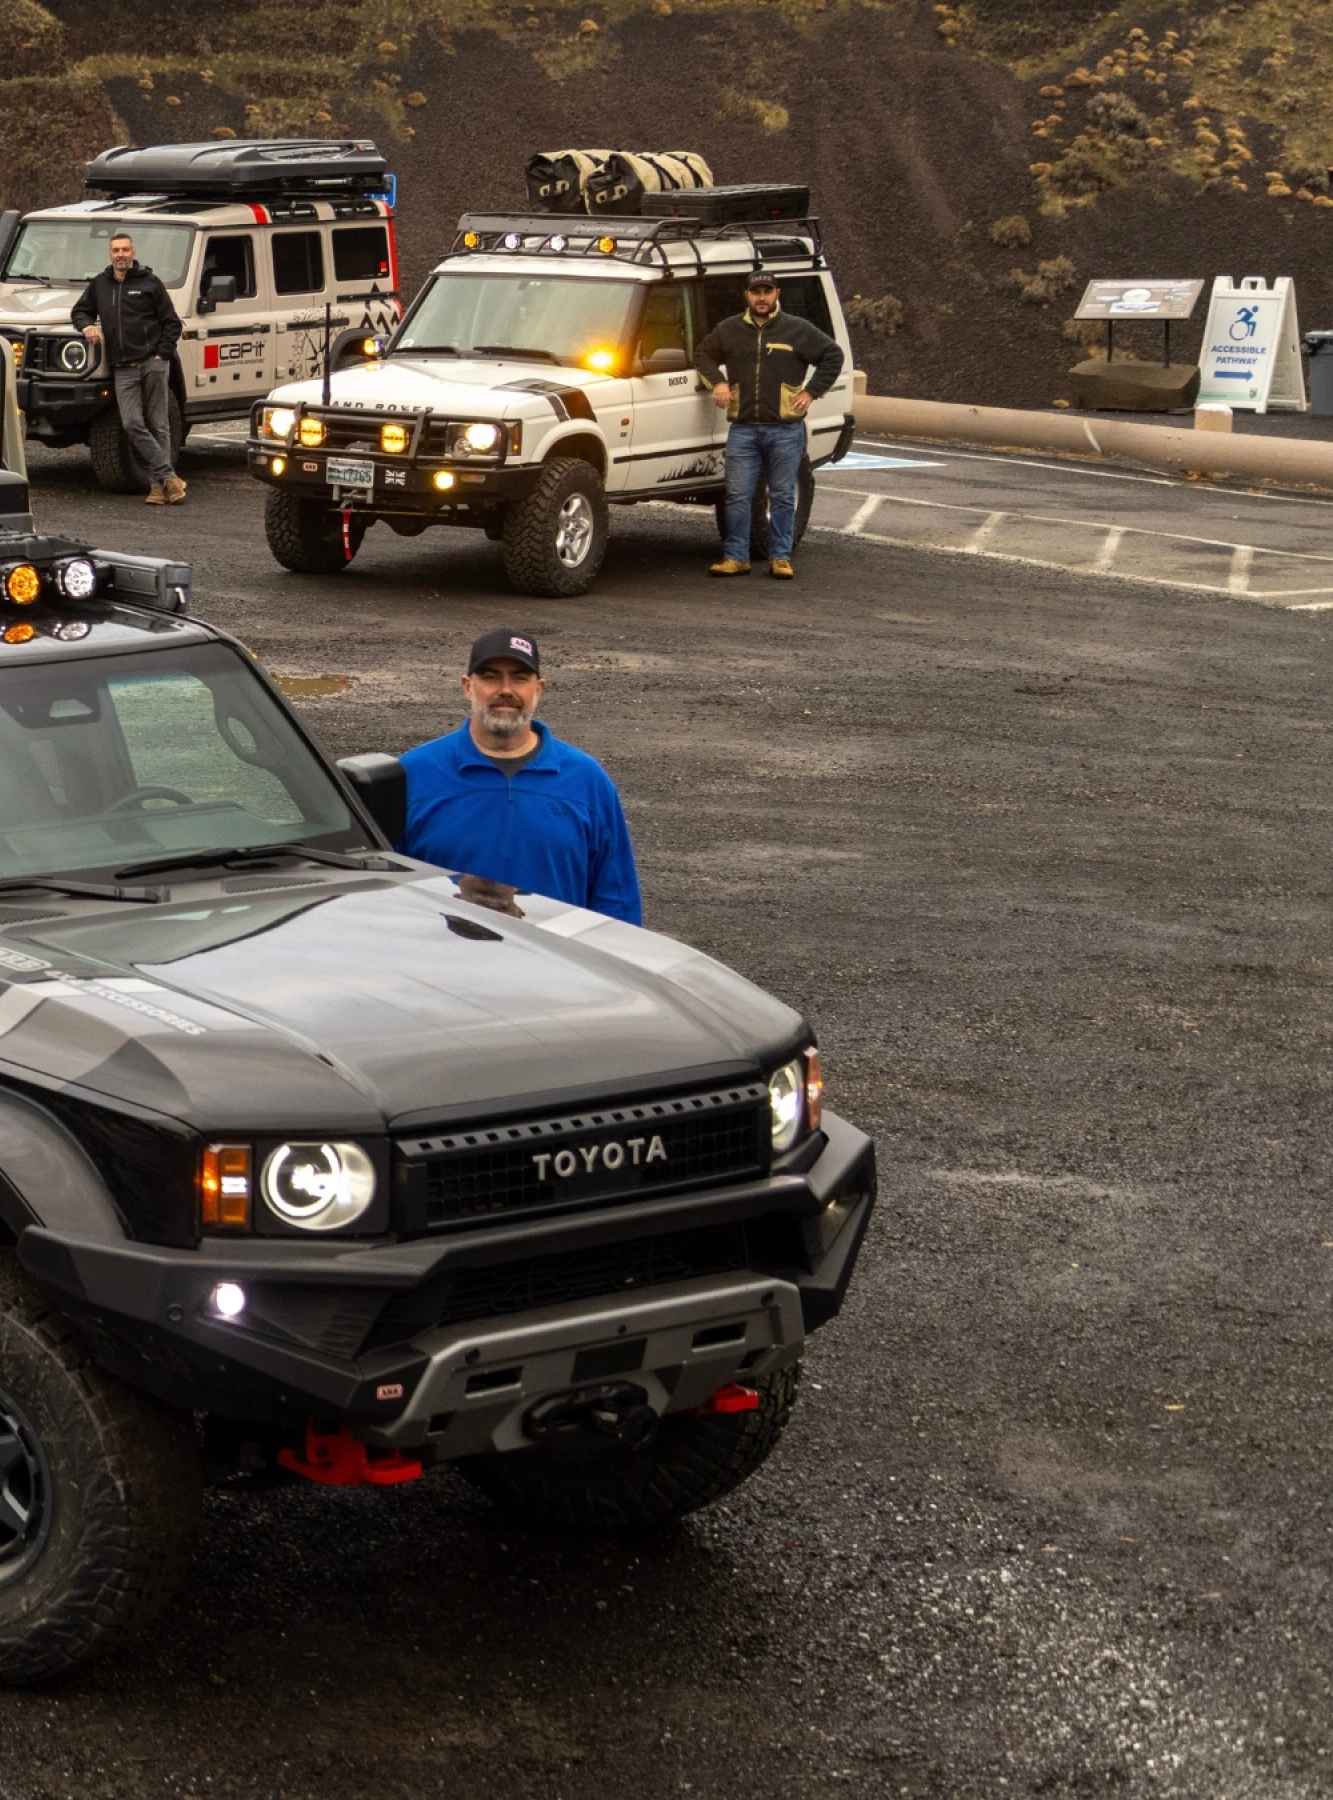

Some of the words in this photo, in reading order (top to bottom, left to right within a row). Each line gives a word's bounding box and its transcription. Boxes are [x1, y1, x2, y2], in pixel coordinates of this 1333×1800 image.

[1211, 345, 1267, 354] ACCESSIBLE
[1216, 356, 1257, 365] PATHWAY
[668, 376, 689, 387] DISCO
[532, 1135, 667, 1181] TOYOTA
